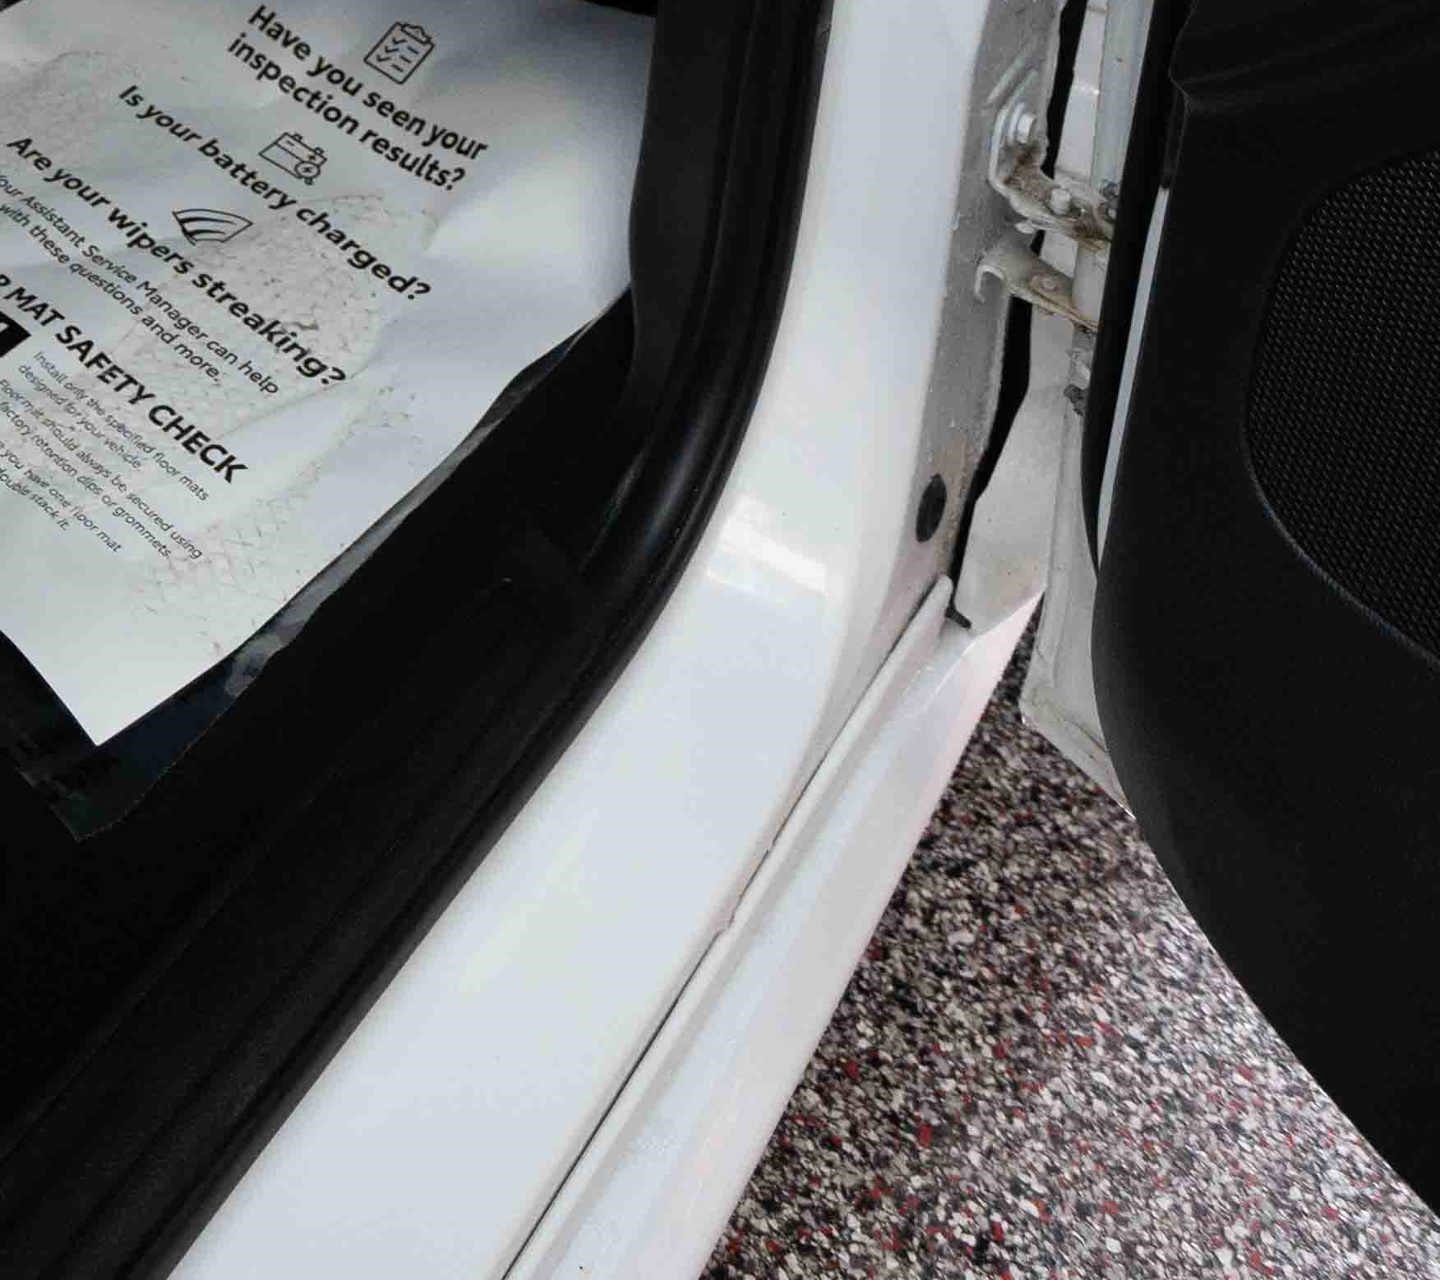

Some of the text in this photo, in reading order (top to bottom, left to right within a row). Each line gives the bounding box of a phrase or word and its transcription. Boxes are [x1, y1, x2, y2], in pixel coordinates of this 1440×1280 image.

[227, 32, 466, 191] inspection results?
[248, 5, 488, 160] Have you seen your
[7, 137, 346, 385] Are your wipers streaking?
[119, 84, 431, 300] Is your battery charged?
[0, 204, 221, 382] with these questions and more.
[19, 193, 86, 251] Assistant
[82, 243, 137, 284] Service
[136, 280, 208, 342] Manager
[207, 340, 237, 366] can
[238, 359, 279, 395] help
[0, 448, 24, 471] you
[5, 287, 65, 328] MAT
[55, 324, 155, 404] SAFETY
[148, 403, 249, 483] CHECK
[34, 351, 65, 383] Install
[153, 452, 181, 477] floor
[180, 475, 209, 501] mats
[126, 491, 172, 533] secured
[171, 531, 203, 559] using
